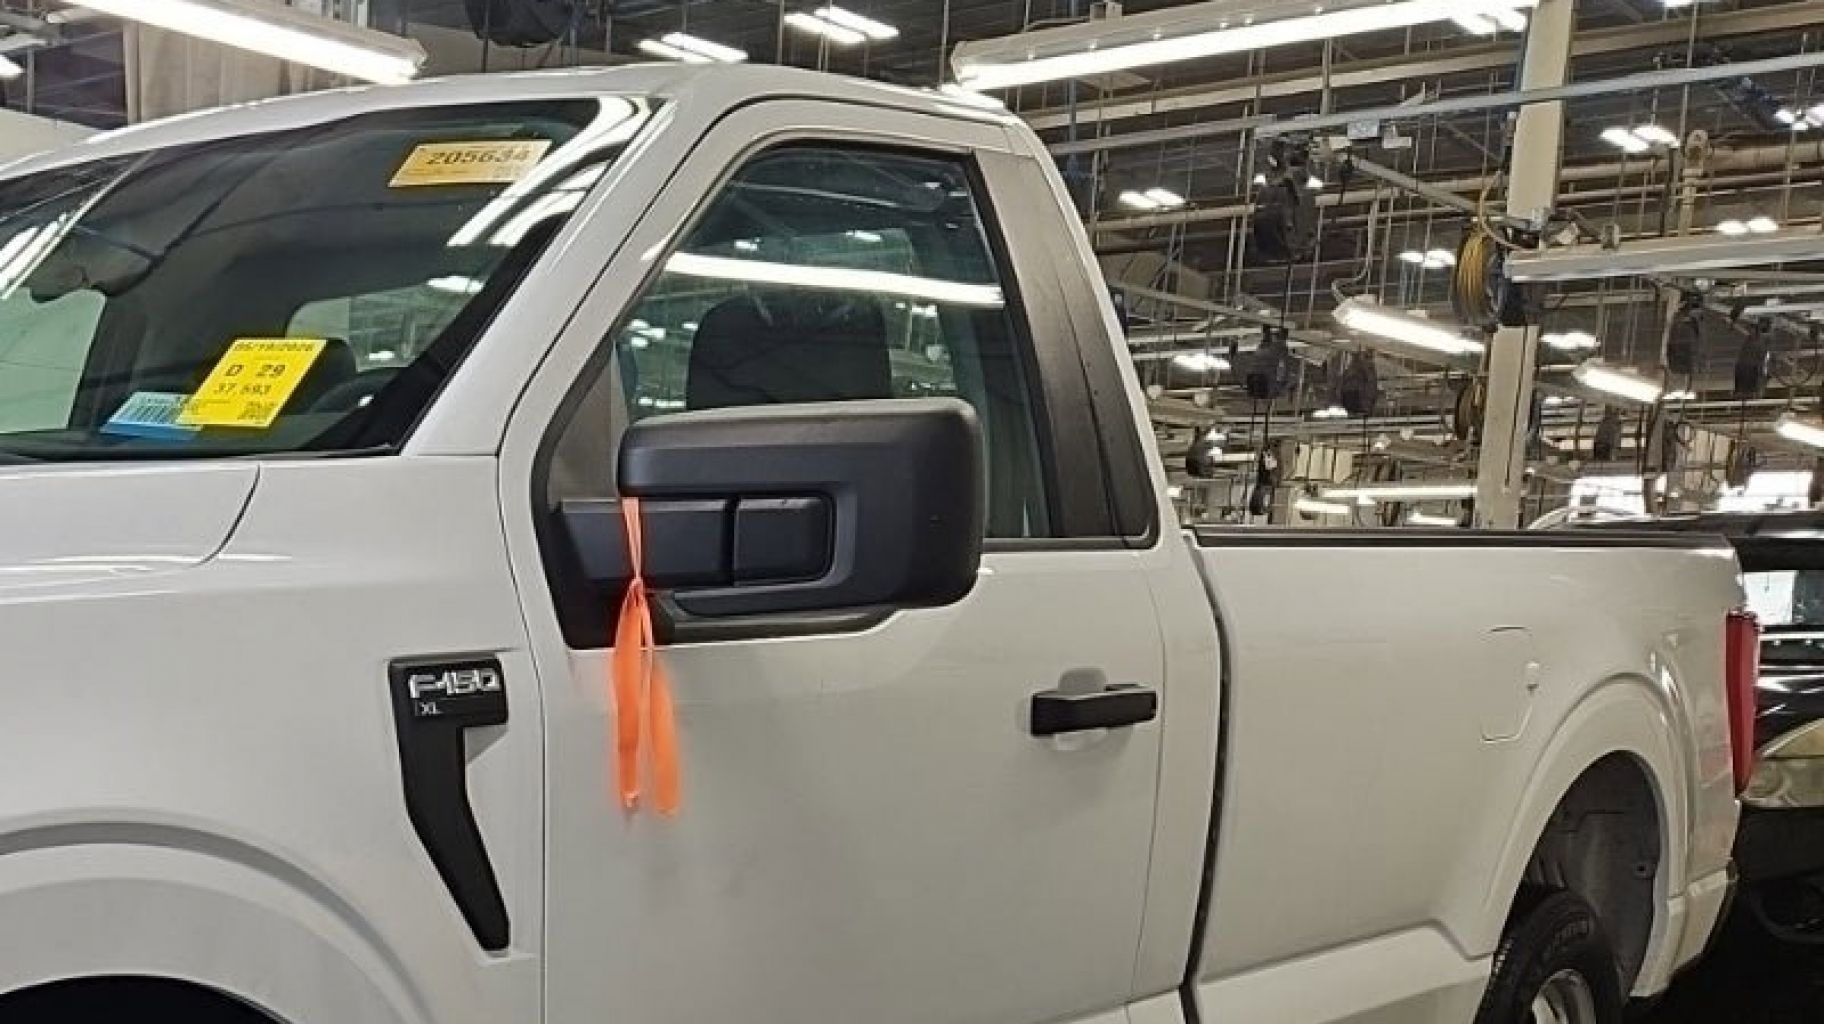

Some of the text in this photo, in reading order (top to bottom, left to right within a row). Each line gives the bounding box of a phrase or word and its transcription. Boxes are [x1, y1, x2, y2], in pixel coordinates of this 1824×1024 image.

[427, 149, 530, 165] 205634
[256, 364, 286, 377] 29
[408, 667, 501, 698] F-150
